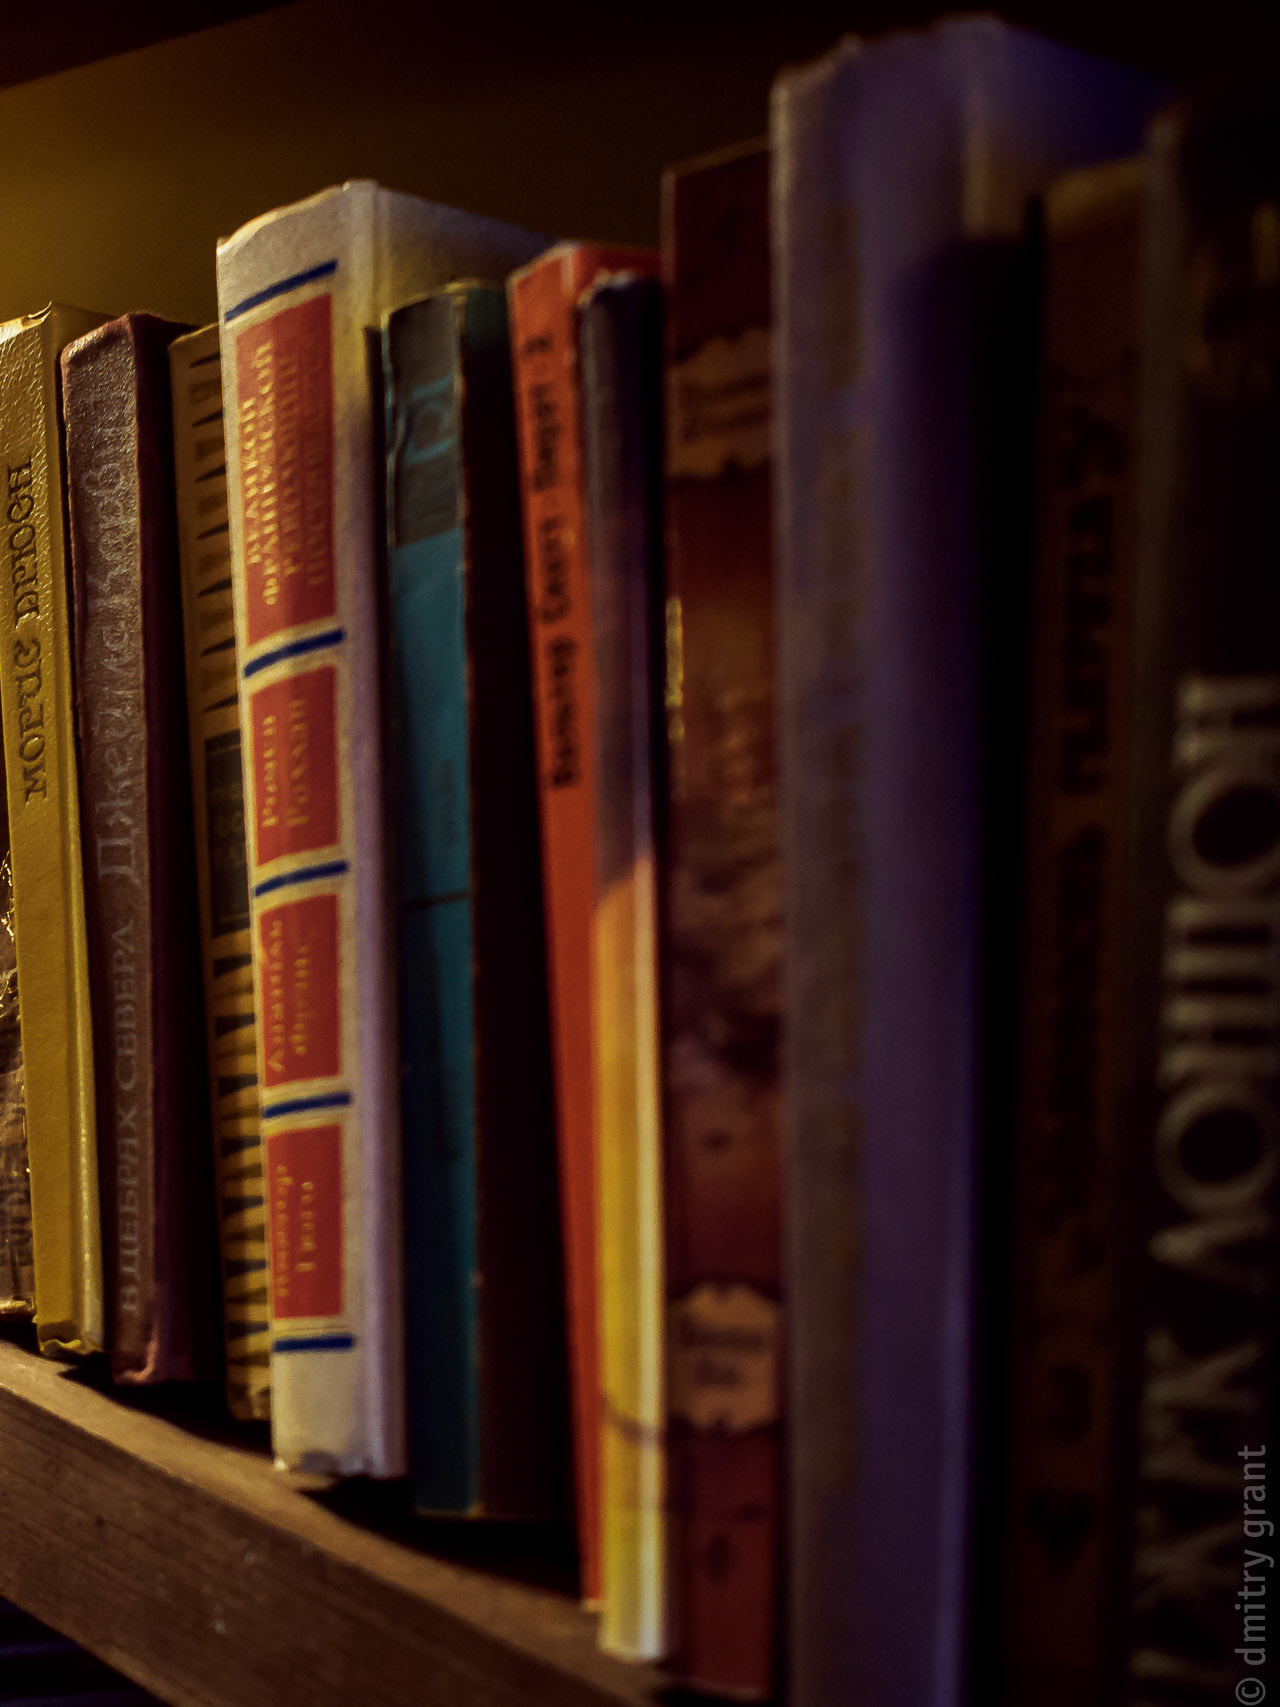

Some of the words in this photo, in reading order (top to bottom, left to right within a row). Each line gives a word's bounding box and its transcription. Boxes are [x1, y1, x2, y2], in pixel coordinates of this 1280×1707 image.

[6, 457, 40, 626] ДРЮОН
[111, 918, 137, 1093] СЕВЕРА
[116, 1103, 141, 1281] ДЕБРЯХ
